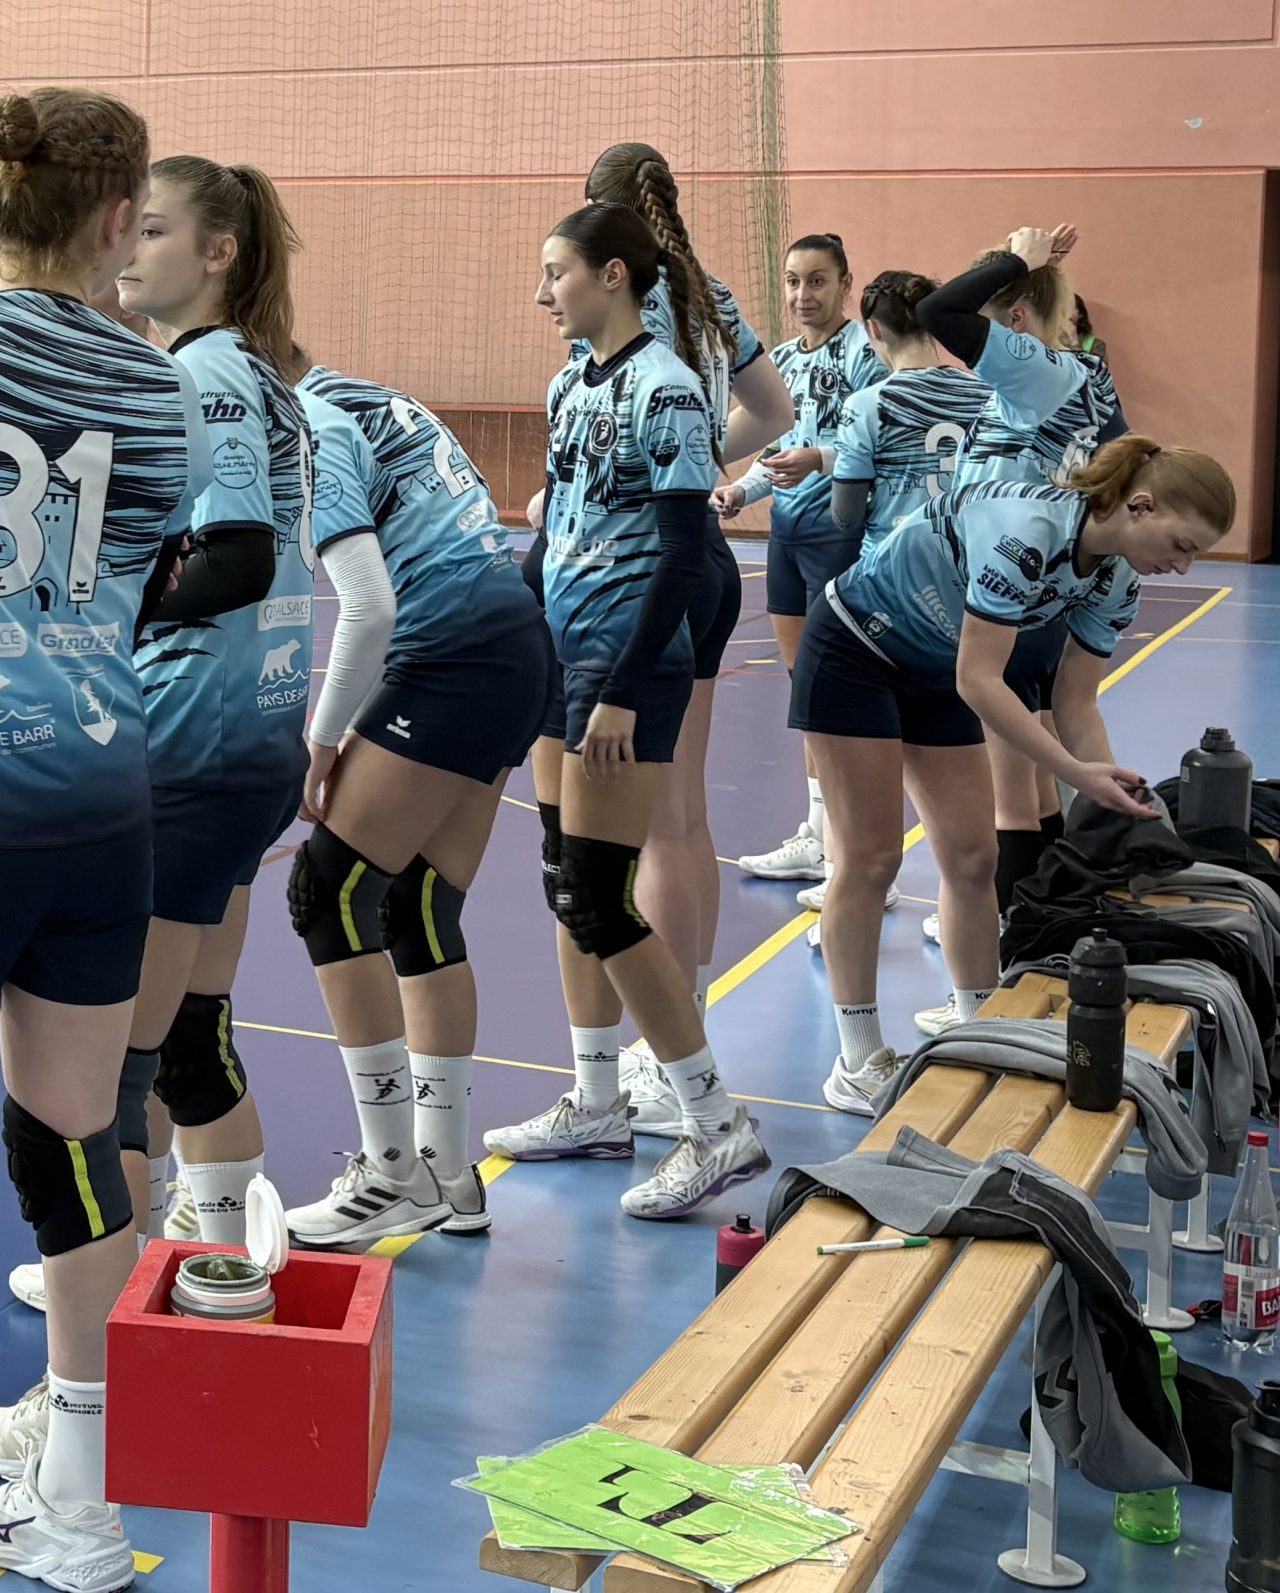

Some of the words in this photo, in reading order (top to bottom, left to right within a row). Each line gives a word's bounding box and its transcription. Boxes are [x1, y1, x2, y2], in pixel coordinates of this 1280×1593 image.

[256, 692, 284, 709] PAYS
[13, 724, 56, 746] BARR
[1261, 1295, 1280, 1317] BA
